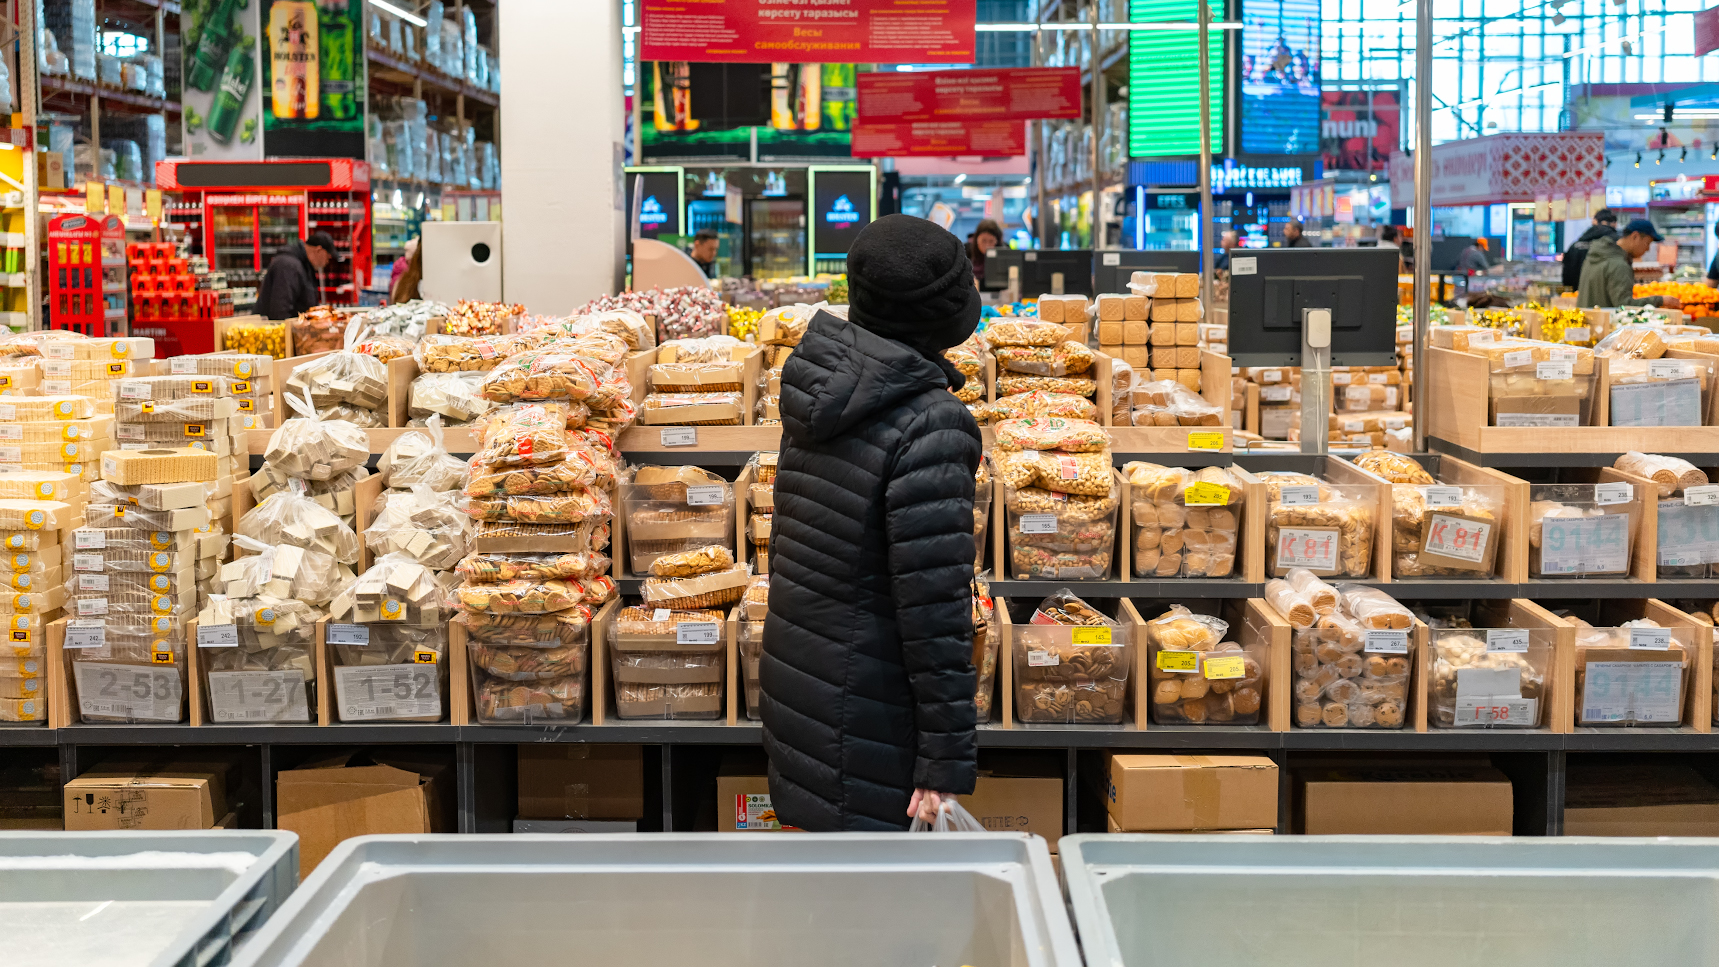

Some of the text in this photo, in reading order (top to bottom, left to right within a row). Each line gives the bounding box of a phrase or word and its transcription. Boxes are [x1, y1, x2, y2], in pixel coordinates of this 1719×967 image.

[758, 9, 859, 20] көрсету таразысы
[793, 27, 823, 38] Весы
[754, 40, 861, 52] самообслуживания
[1453, 528, 1481, 551] 81
[1303, 538, 1330, 559] 81
[231, 677, 302, 704] 1-27
[1491, 706, 1509, 720] 58
